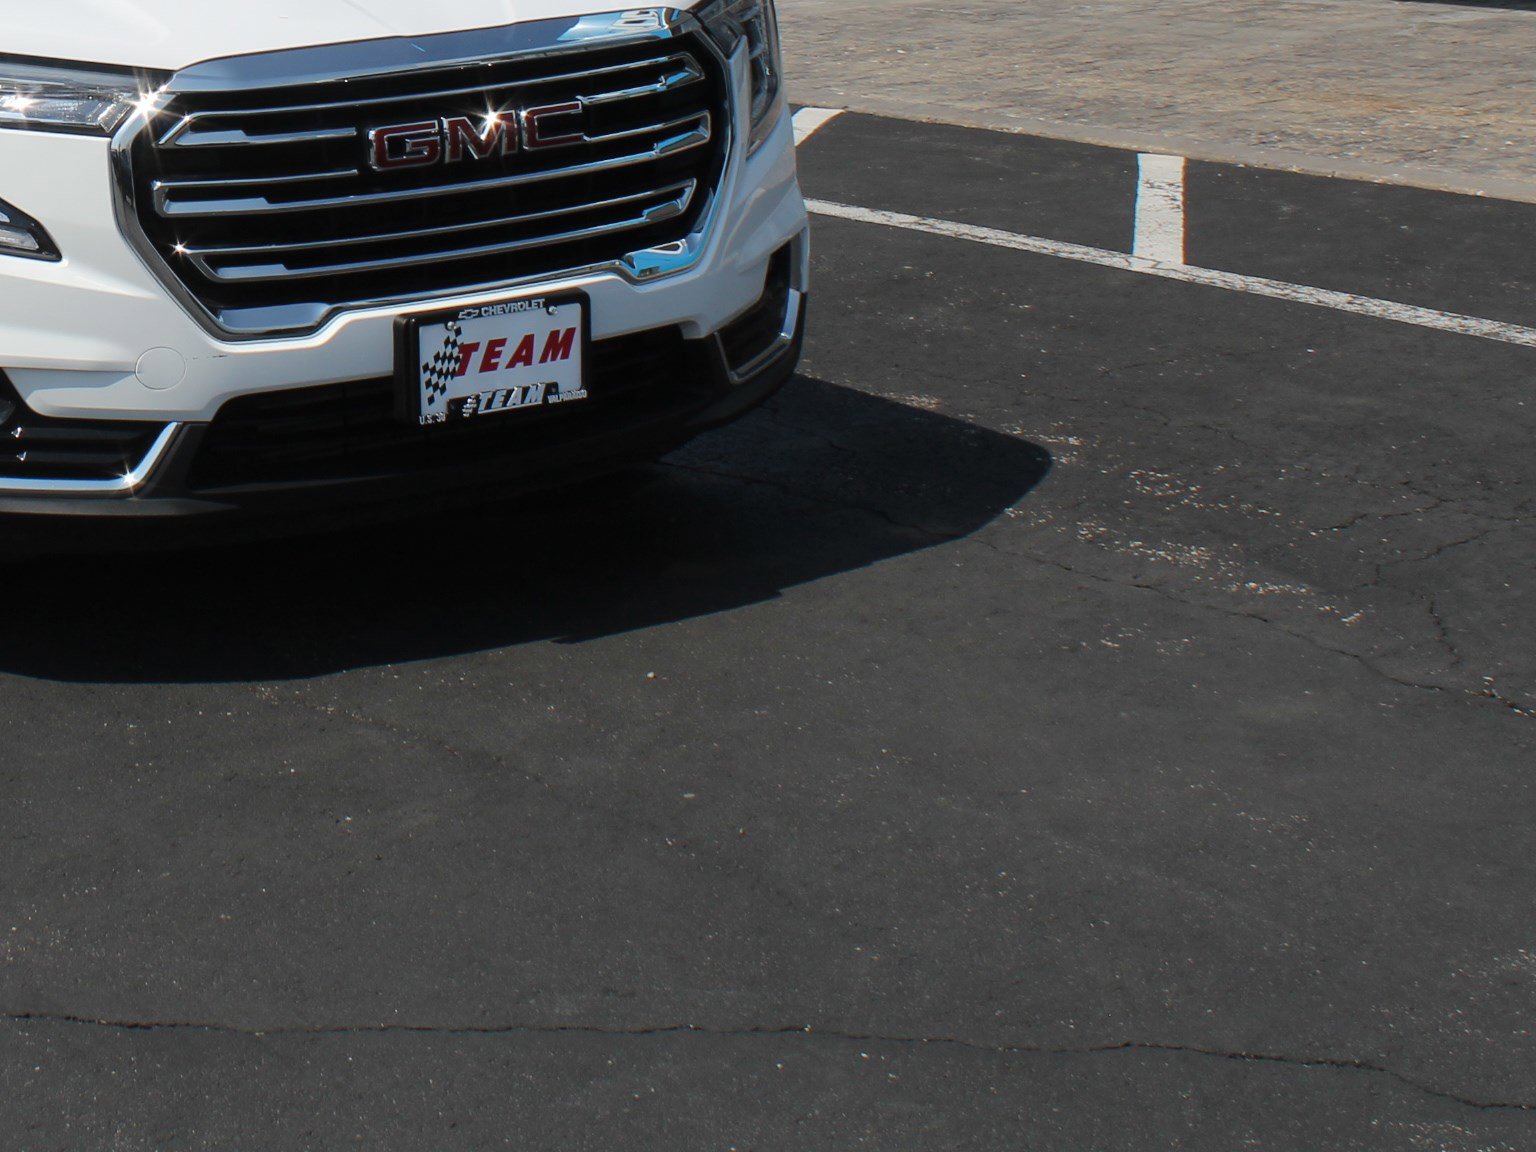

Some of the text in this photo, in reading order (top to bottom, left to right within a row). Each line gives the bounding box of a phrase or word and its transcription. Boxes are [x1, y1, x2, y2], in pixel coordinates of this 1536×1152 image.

[368, 100, 585, 171] GMC
[480, 298, 546, 317] CHEVROLET
[454, 326, 577, 378] TEAM
[478, 382, 547, 413] TEAM
